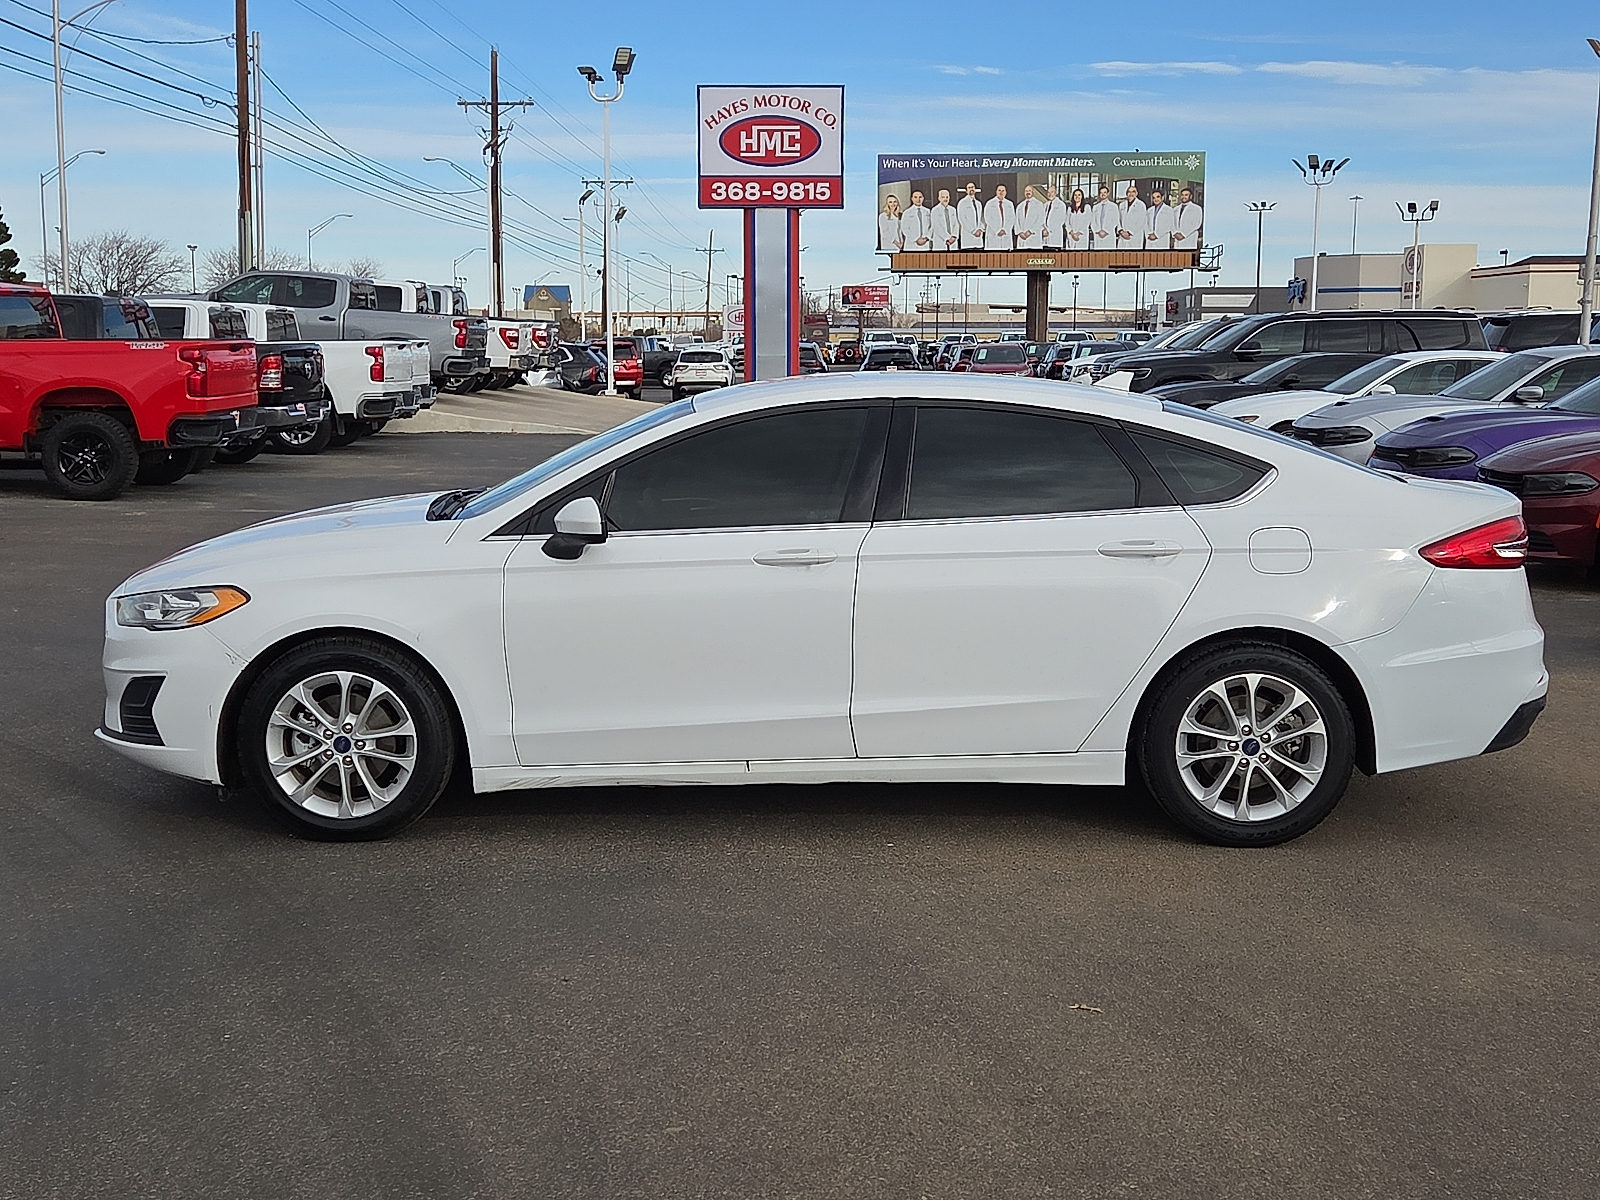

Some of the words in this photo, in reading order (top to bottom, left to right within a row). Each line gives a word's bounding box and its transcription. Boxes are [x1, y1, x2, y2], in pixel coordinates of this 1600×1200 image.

[704, 98, 749, 130] HAYES
[753, 94, 812, 114] MOTOR
[814, 107, 837, 130] CO.
[739, 125, 800, 157] HMC
[882, 158, 910, 169] When
[911, 158, 926, 168] It's
[927, 158, 949, 168] Your
[951, 158, 980, 169] Heart,
[981, 158, 1011, 169] Every
[1012, 157, 1054, 167] Moment
[1054, 157, 1096, 167] Matters.
[711, 182, 831, 201] 368-9815
